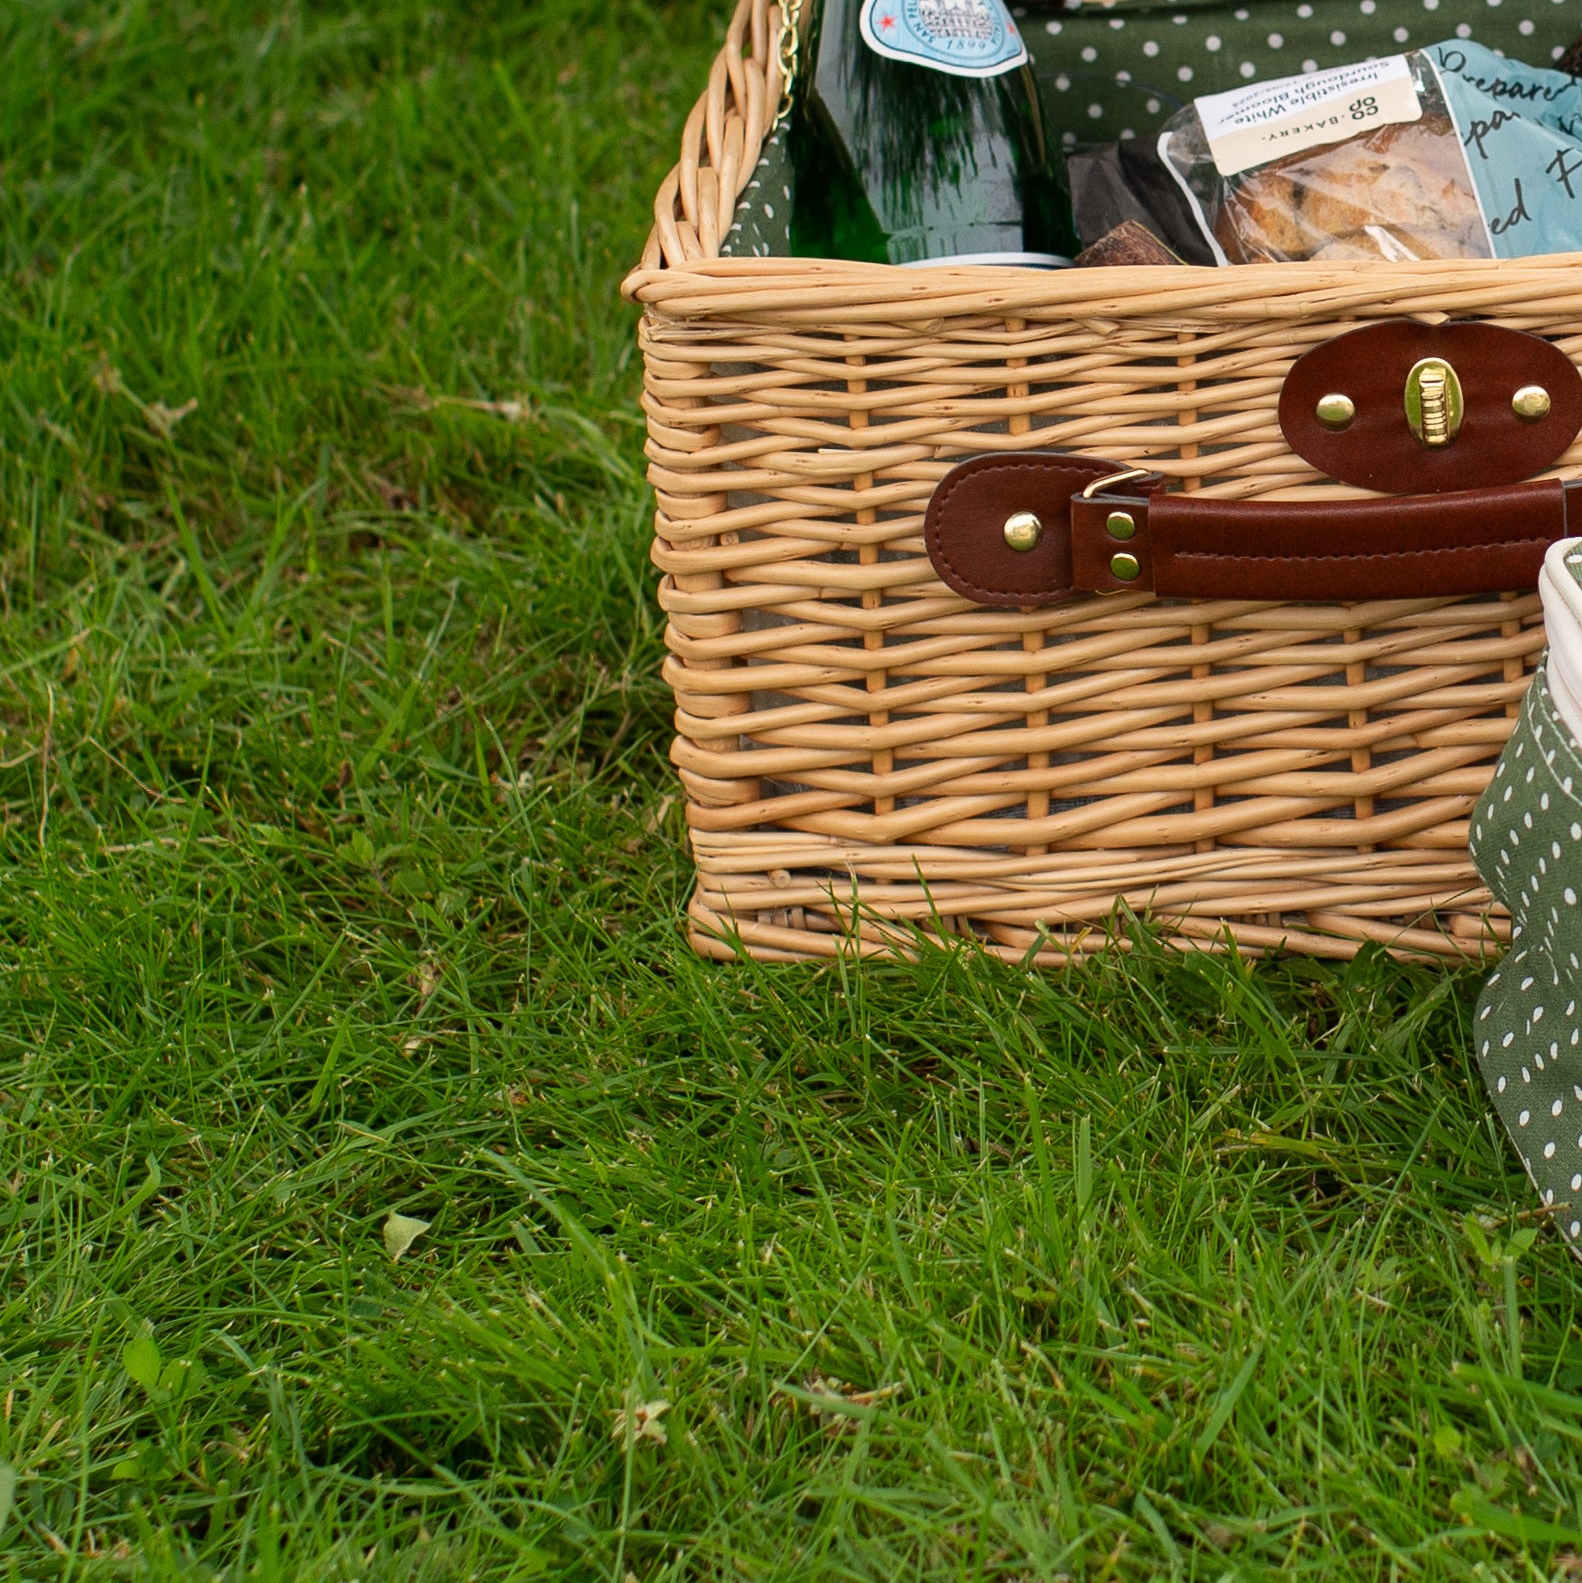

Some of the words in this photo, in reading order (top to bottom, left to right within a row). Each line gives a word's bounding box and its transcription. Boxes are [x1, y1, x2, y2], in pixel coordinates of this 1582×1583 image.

[1290, 72, 1378, 105] Irresistible
[1294, 61, 1390, 95] Sourdough
[1219, 92, 1290, 123] Bloomer
[1234, 104, 1287, 124] White
